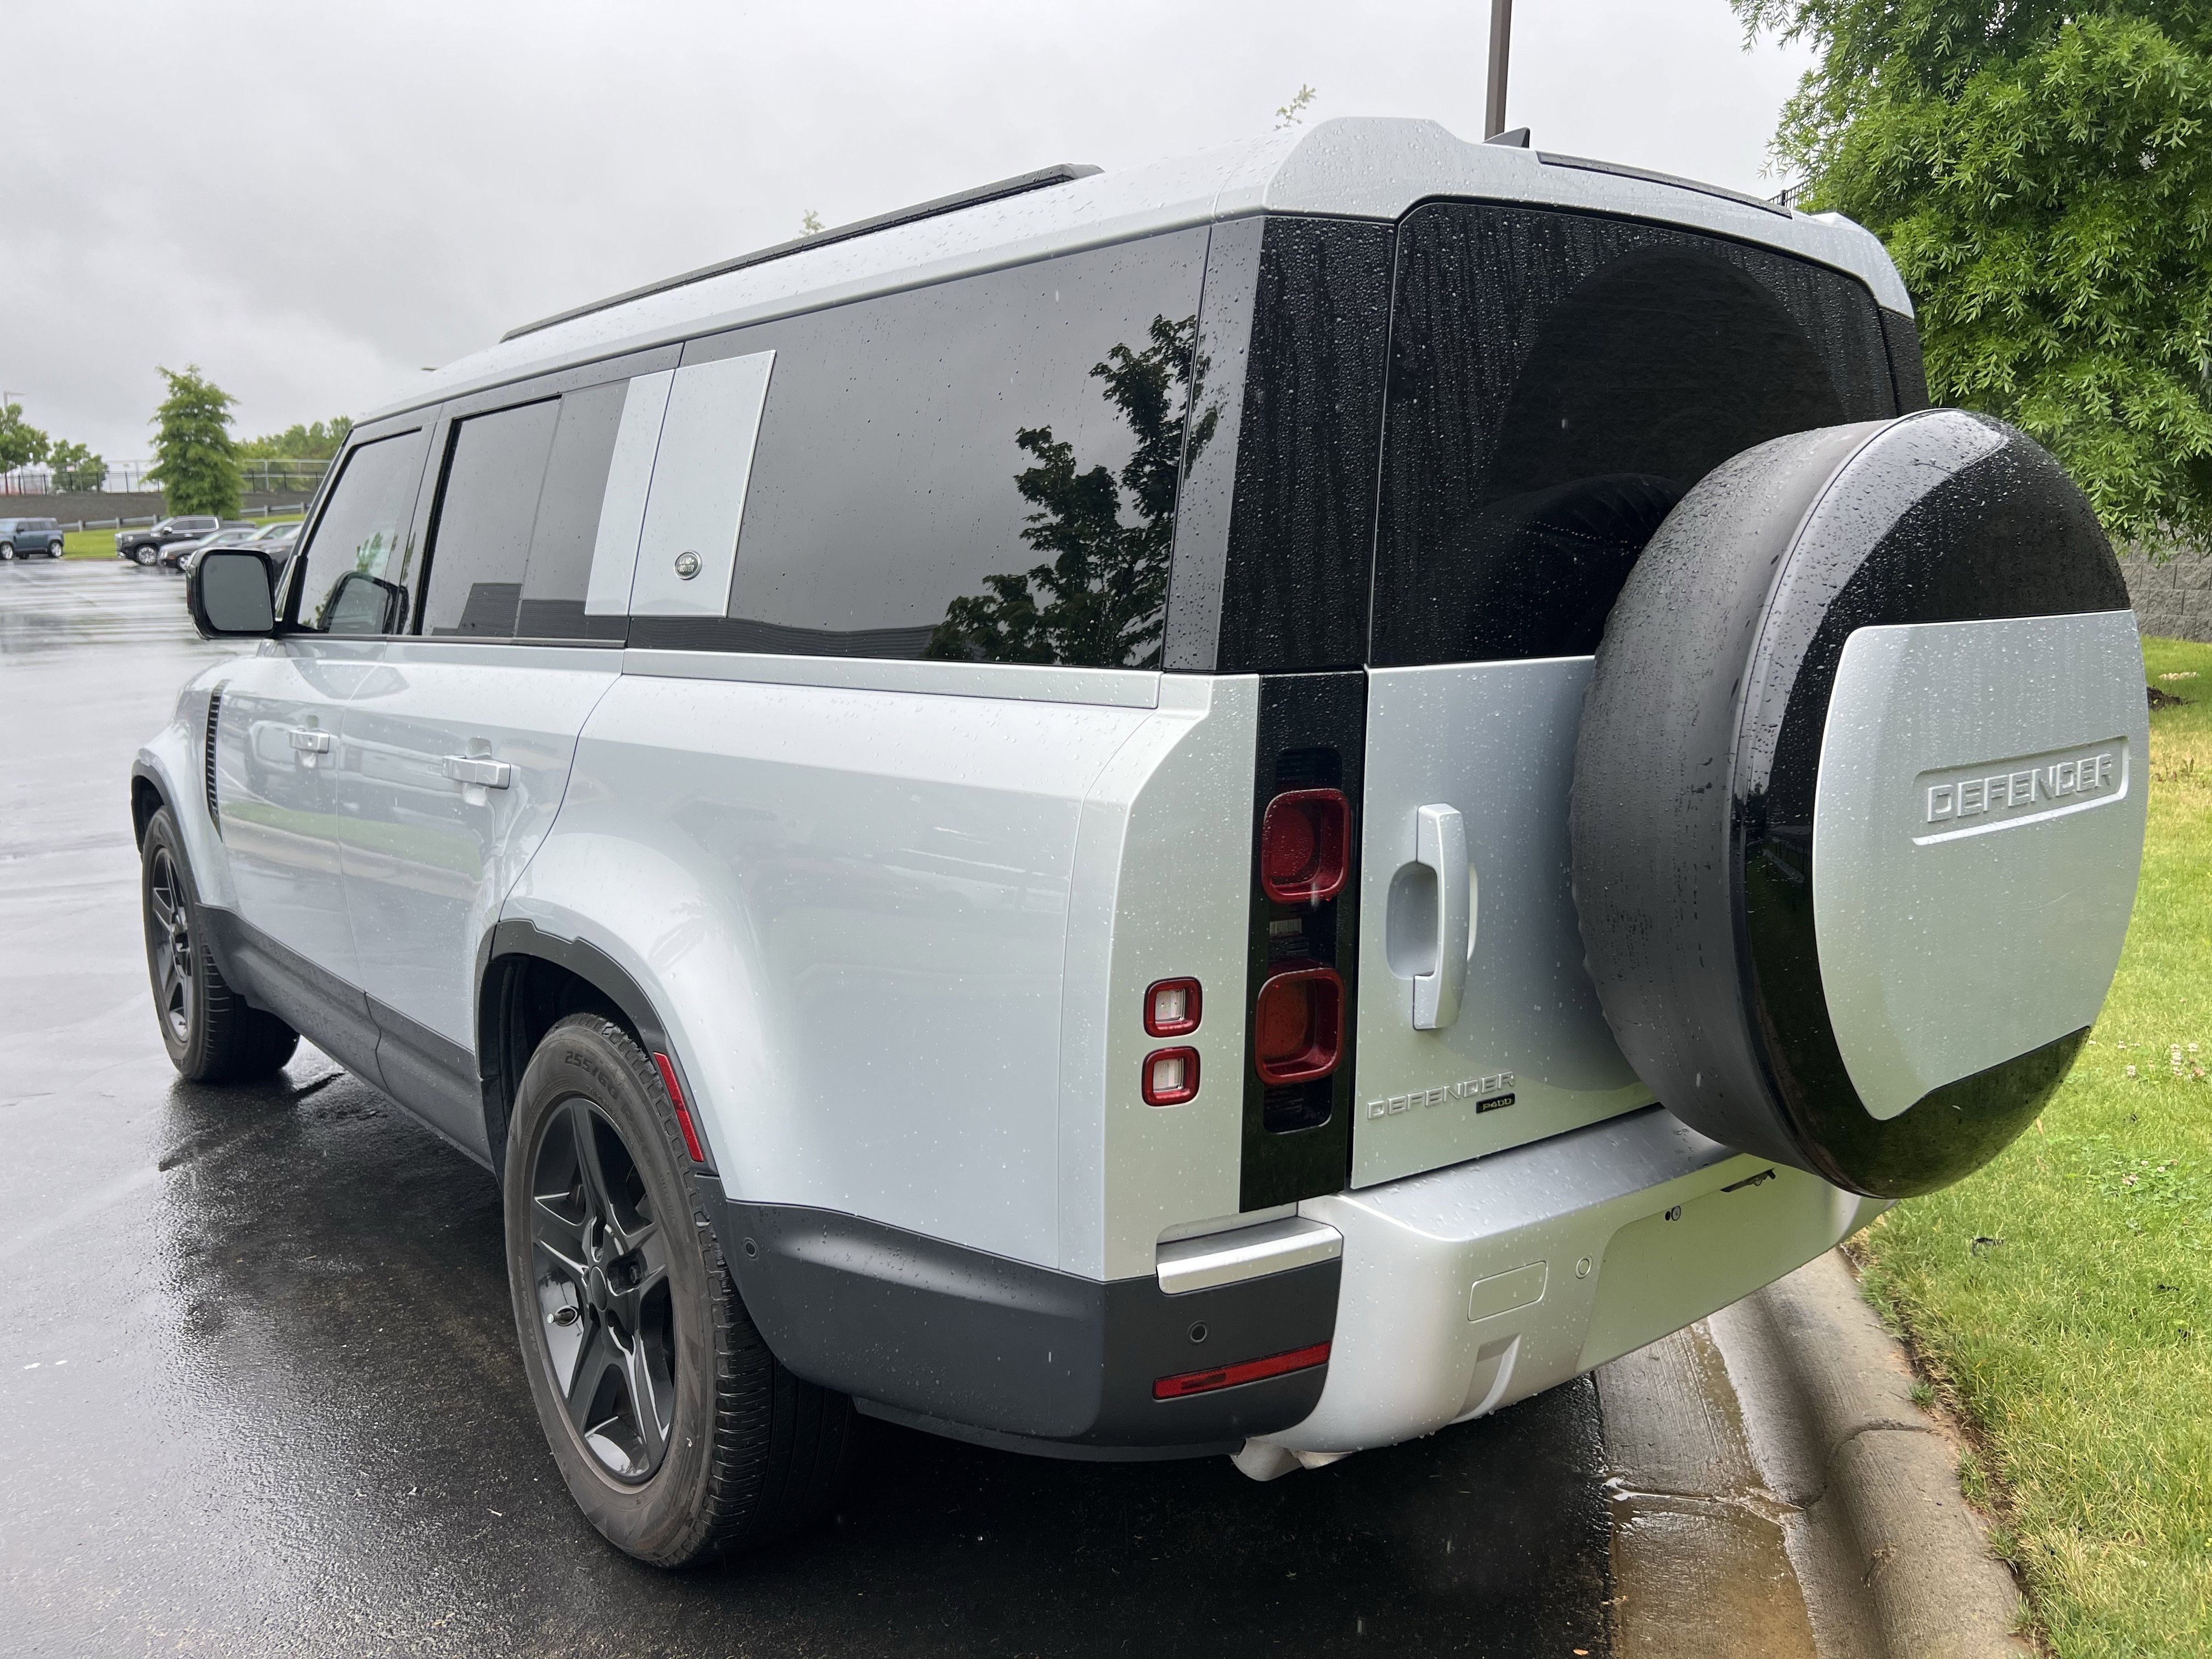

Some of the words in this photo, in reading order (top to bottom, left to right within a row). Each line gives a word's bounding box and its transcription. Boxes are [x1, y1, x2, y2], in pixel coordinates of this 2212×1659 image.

[1926, 753, 2112, 823] DEFENDER
[1367, 1071, 1515, 1119] DEFENDER
[1482, 1097, 1513, 1111] P400
